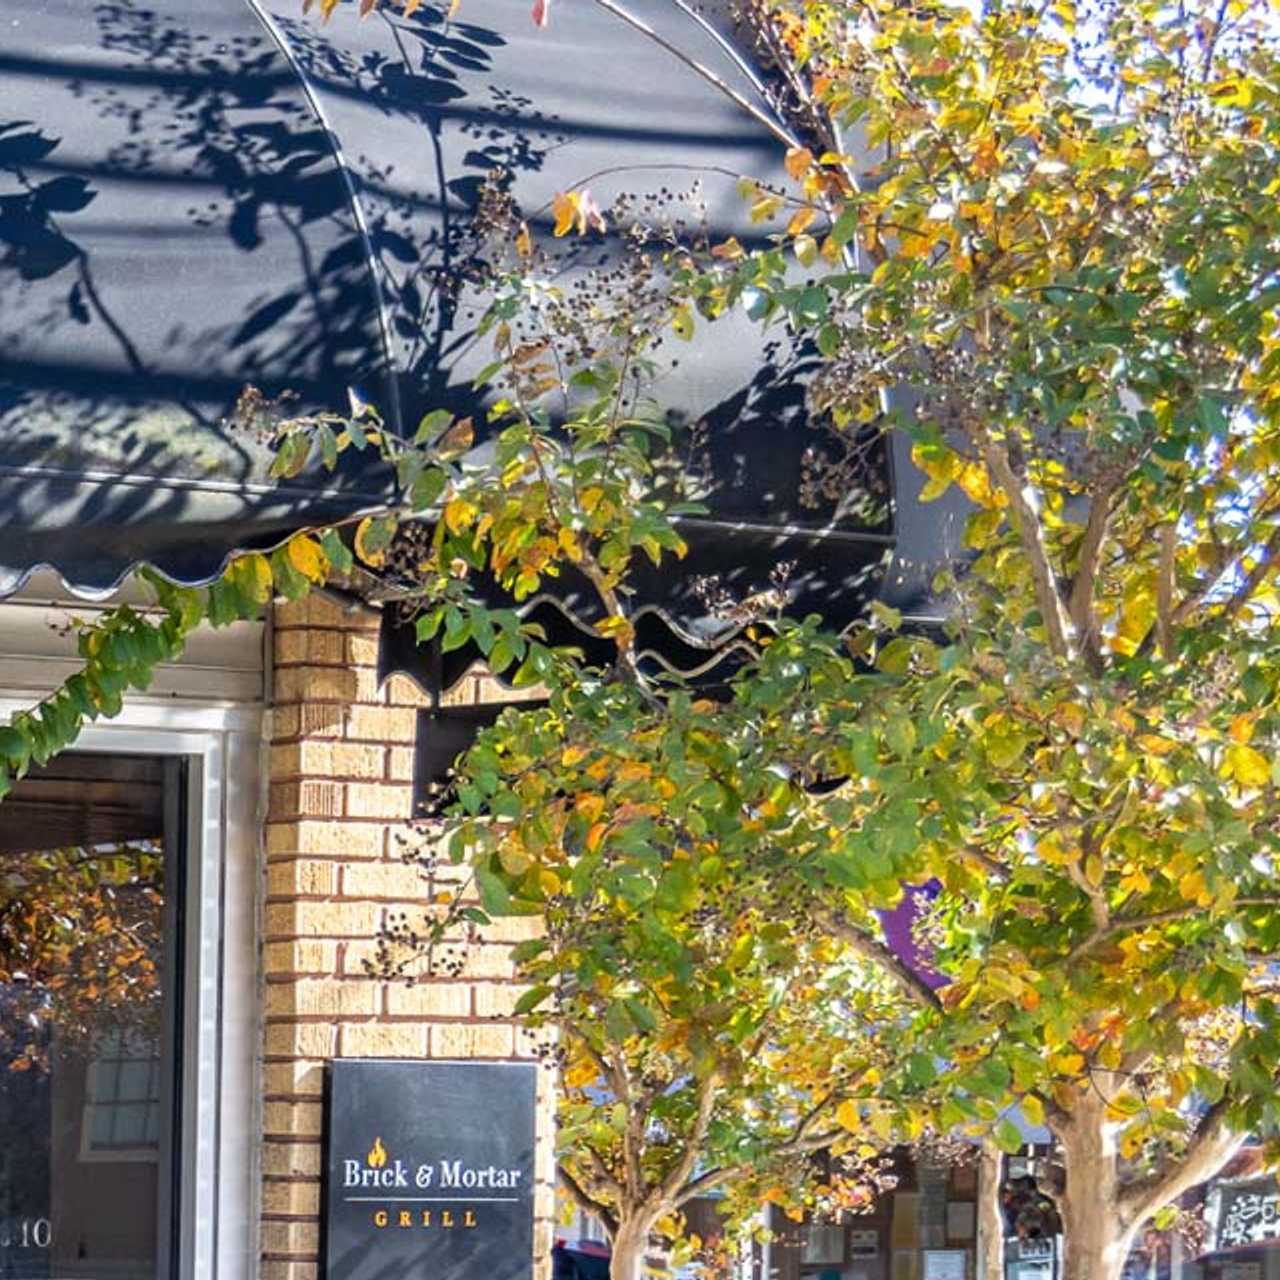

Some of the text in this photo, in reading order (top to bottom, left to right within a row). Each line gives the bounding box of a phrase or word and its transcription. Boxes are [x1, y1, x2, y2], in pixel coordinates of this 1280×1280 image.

[343, 1160, 521, 1188] Brick & Mortar
[374, 1210, 477, 1227] GRILL
